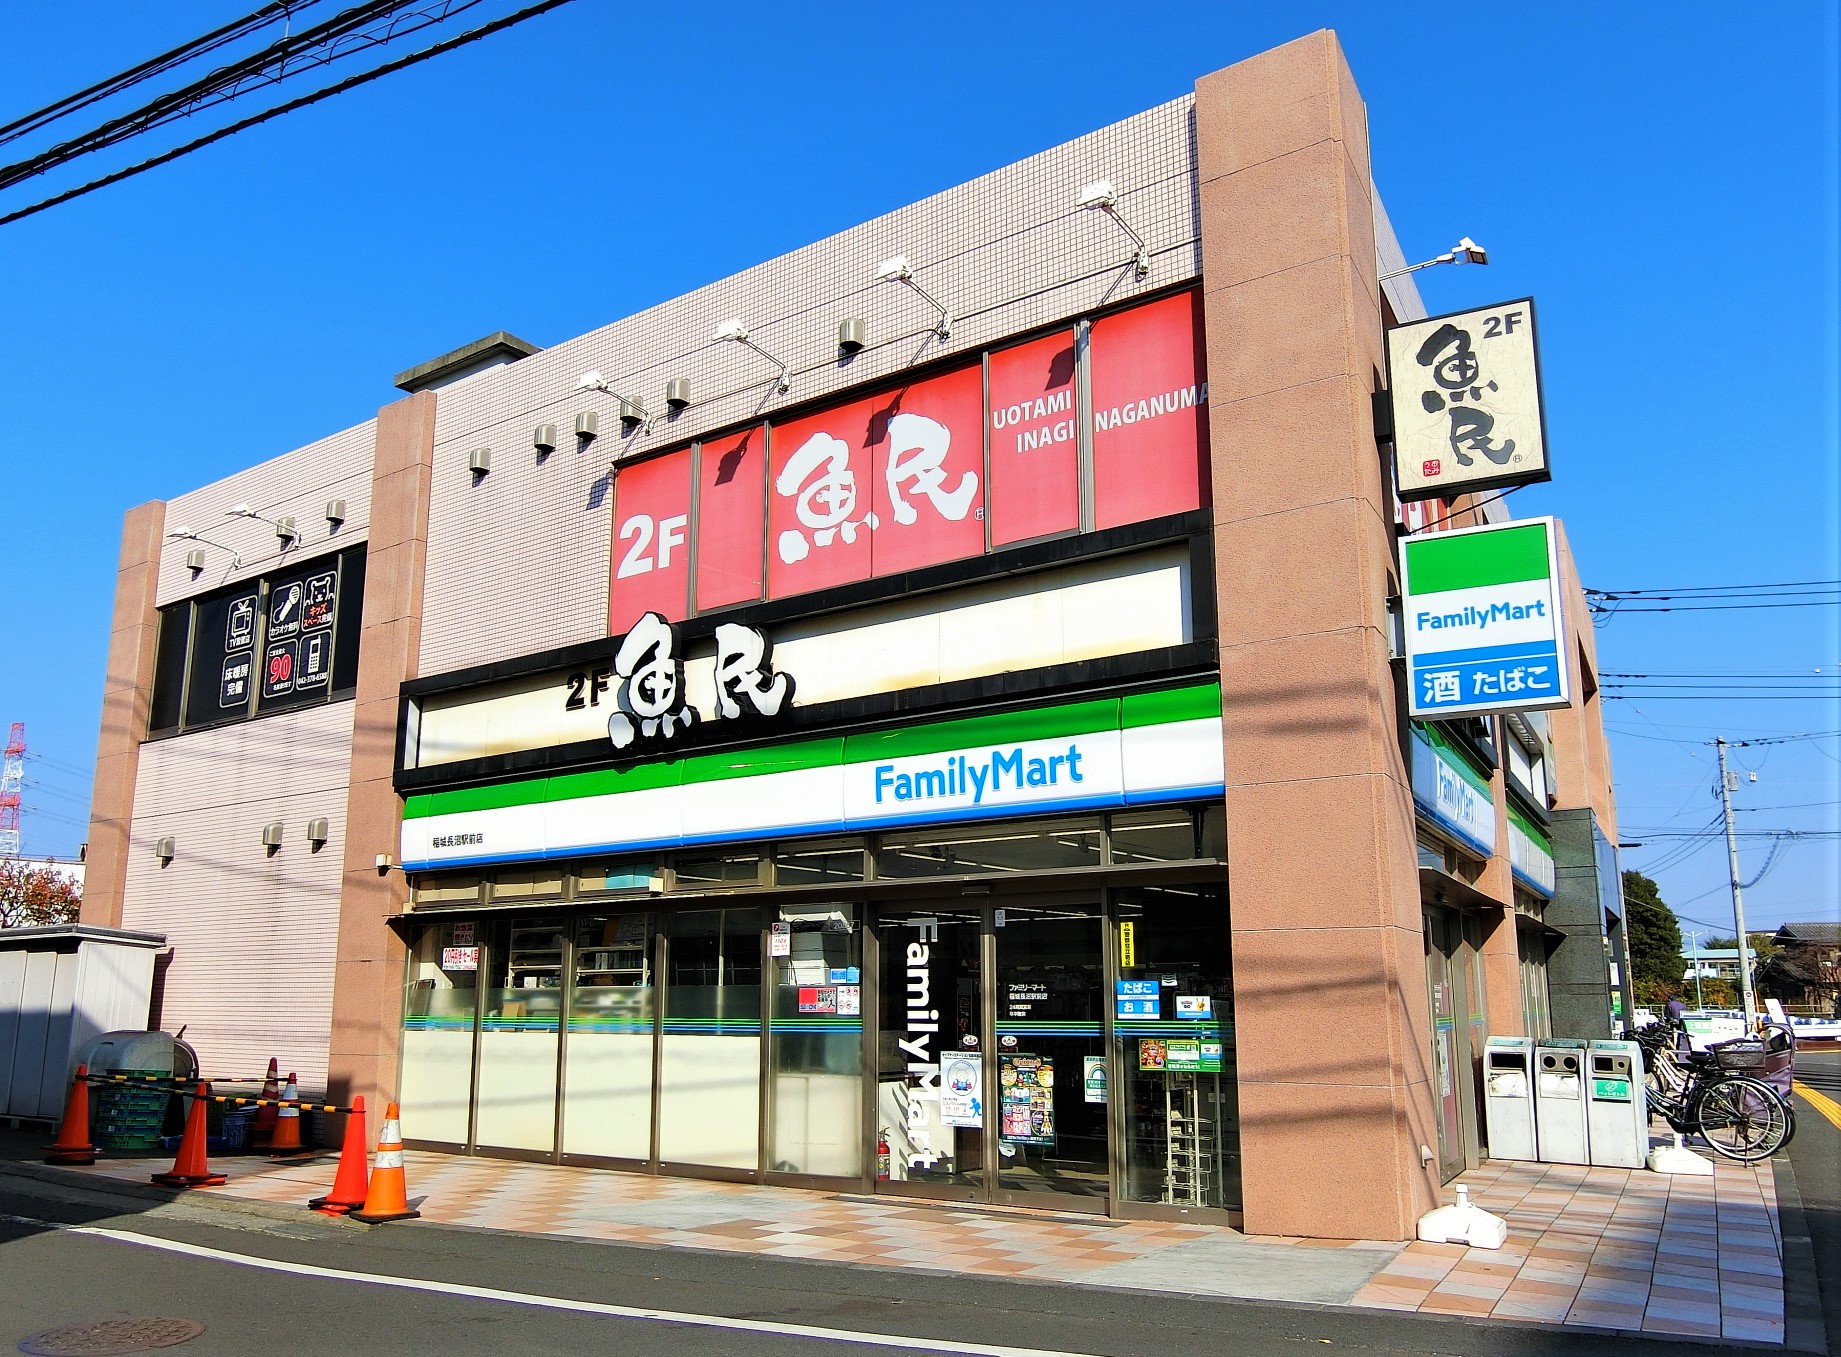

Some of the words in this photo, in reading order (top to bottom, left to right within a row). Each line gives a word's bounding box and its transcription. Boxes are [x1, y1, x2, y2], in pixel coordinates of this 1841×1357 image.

[1483, 312, 1523, 339] 2F
[993, 390, 1072, 430] UOTAMI
[1416, 323, 1515, 466] 魚民
[1016, 419, 1075, 454] INAGI
[775, 413, 979, 565] 魚民
[616, 513, 688, 580] 2F
[1416, 599, 1545, 631] FamilyMart
[224, 663, 249, 681] 床暖房
[269, 653, 292, 684] 90
[608, 611, 796, 750] 魚民
[1422, 670, 1461, 704] 酒
[1472, 666, 1551, 695] たばこ
[226, 680, 244, 697] 完備
[566, 667, 610, 712] 2F
[875, 744, 1084, 805] FamilyMart
[1008, 983, 1047, 992] ファミリーマート
[1123, 982, 1153, 994] たばこ
[899, 917, 941, 1172] FamilyMart
